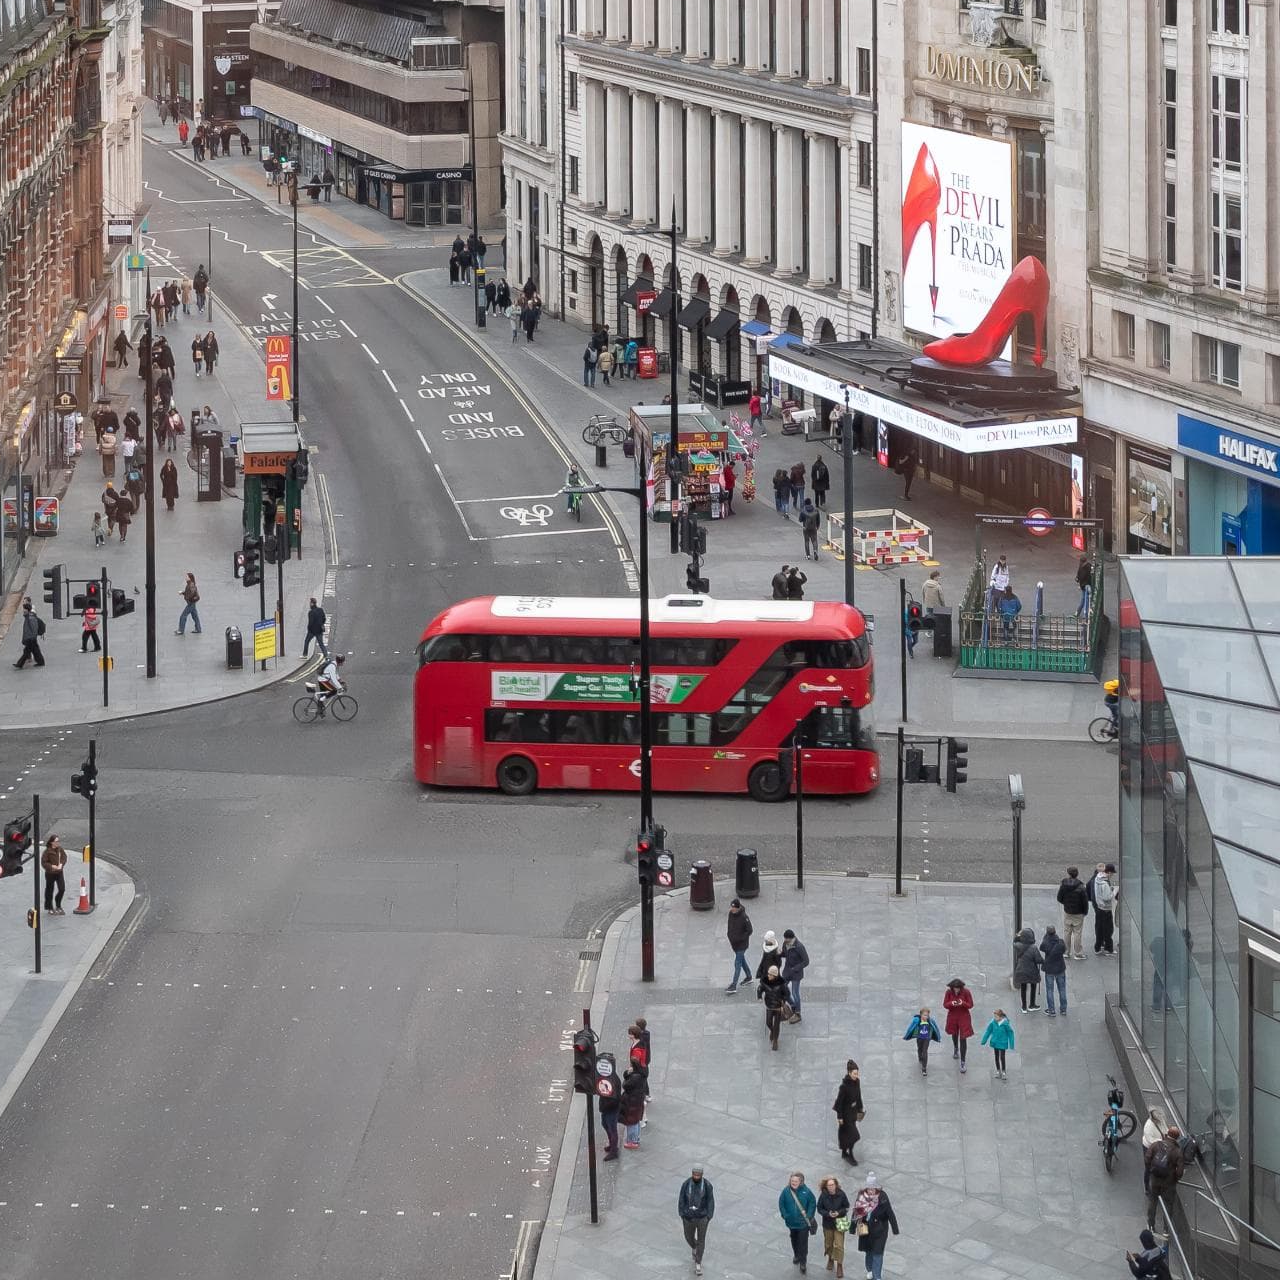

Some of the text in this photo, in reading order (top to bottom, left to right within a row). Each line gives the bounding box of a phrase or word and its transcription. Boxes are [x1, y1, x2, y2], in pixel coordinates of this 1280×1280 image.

[927, 45, 1033, 94] DOMINION
[436, 171, 462, 179] CASINO
[951, 172, 970, 190] THE
[944, 187, 1005, 229] DEVIL
[960, 220, 994, 242] WEARS
[950, 226, 1006, 270] PRADA
[244, 319, 337, 335] TRAFFIC
[253, 330, 342, 347] RTES
[419, 372, 477, 385] ONLY
[417, 384, 491, 399] AHEAD
[448, 411, 494, 424] AND
[441, 425, 525, 441] BUSES
[941, 423, 961, 443] JOHN
[987, 428, 1017, 442] DEVIL
[1037, 424, 1073, 437] PRADA
[1219, 435, 1277, 473] HALIFAX
[563, 683, 586, 691] Super
[576, 675, 599, 683] Super
